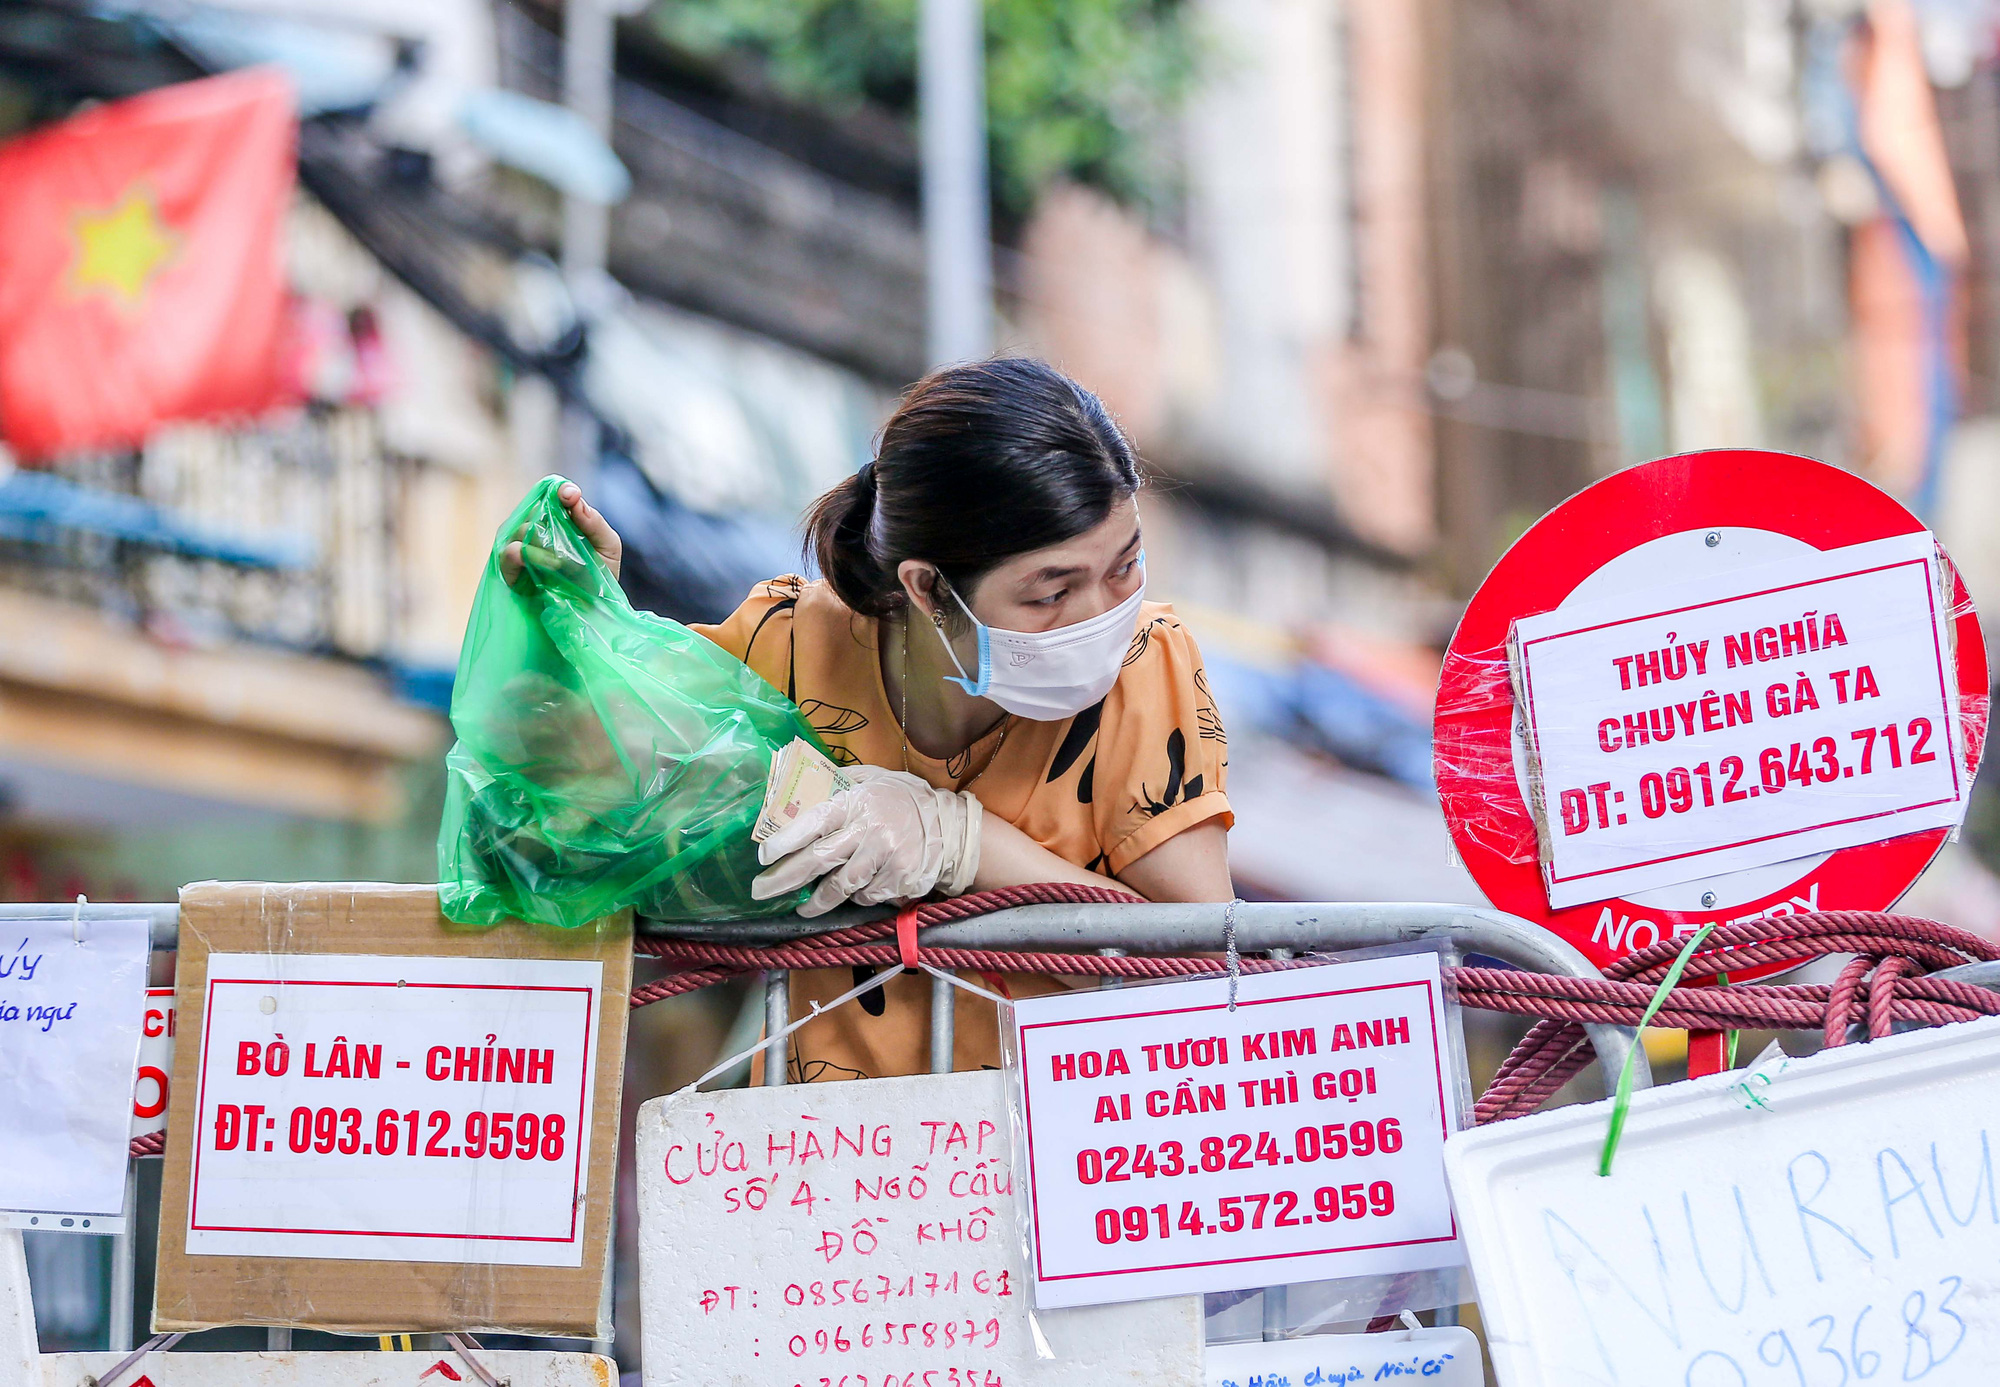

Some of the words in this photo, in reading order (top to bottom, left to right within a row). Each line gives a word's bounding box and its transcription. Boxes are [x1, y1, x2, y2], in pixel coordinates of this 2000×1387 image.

[1612, 631, 1710, 691] THỦY
[1723, 610, 1848, 669] NGHĨA
[1598, 689, 1754, 753] CHUYÊN
[1765, 671, 1820, 719] GÀ
[1829, 665, 1881, 704] TA
[1560, 781, 1628, 836] ĐT:
[1639, 717, 1936, 819] 0912.643.712
[236, 1033, 291, 1078] BÒ
[303, 1035, 383, 1080] LÂN
[425, 1033, 555, 1085] CHỈNH
[1051, 1048, 1131, 1082] HOA
[1141, 1036, 1229, 1072] TƯƠI
[1242, 1027, 1317, 1062] KIM
[1331, 1016, 1410, 1052] ANH
[1094, 1093, 1132, 1124] AI
[1145, 1077, 1227, 1118] CẦN
[1237, 1070, 1299, 1108] THÌ
[1312, 1067, 1377, 1103] GỌI
[214, 1103, 276, 1153] ĐT:
[288, 1105, 566, 1162] 093.612.9598
[920, 1120, 996, 1161] TẠP
[1076, 1117, 1403, 1185] 0243.824.0596
[1095, 1180, 1395, 1245] 0914.572.959
